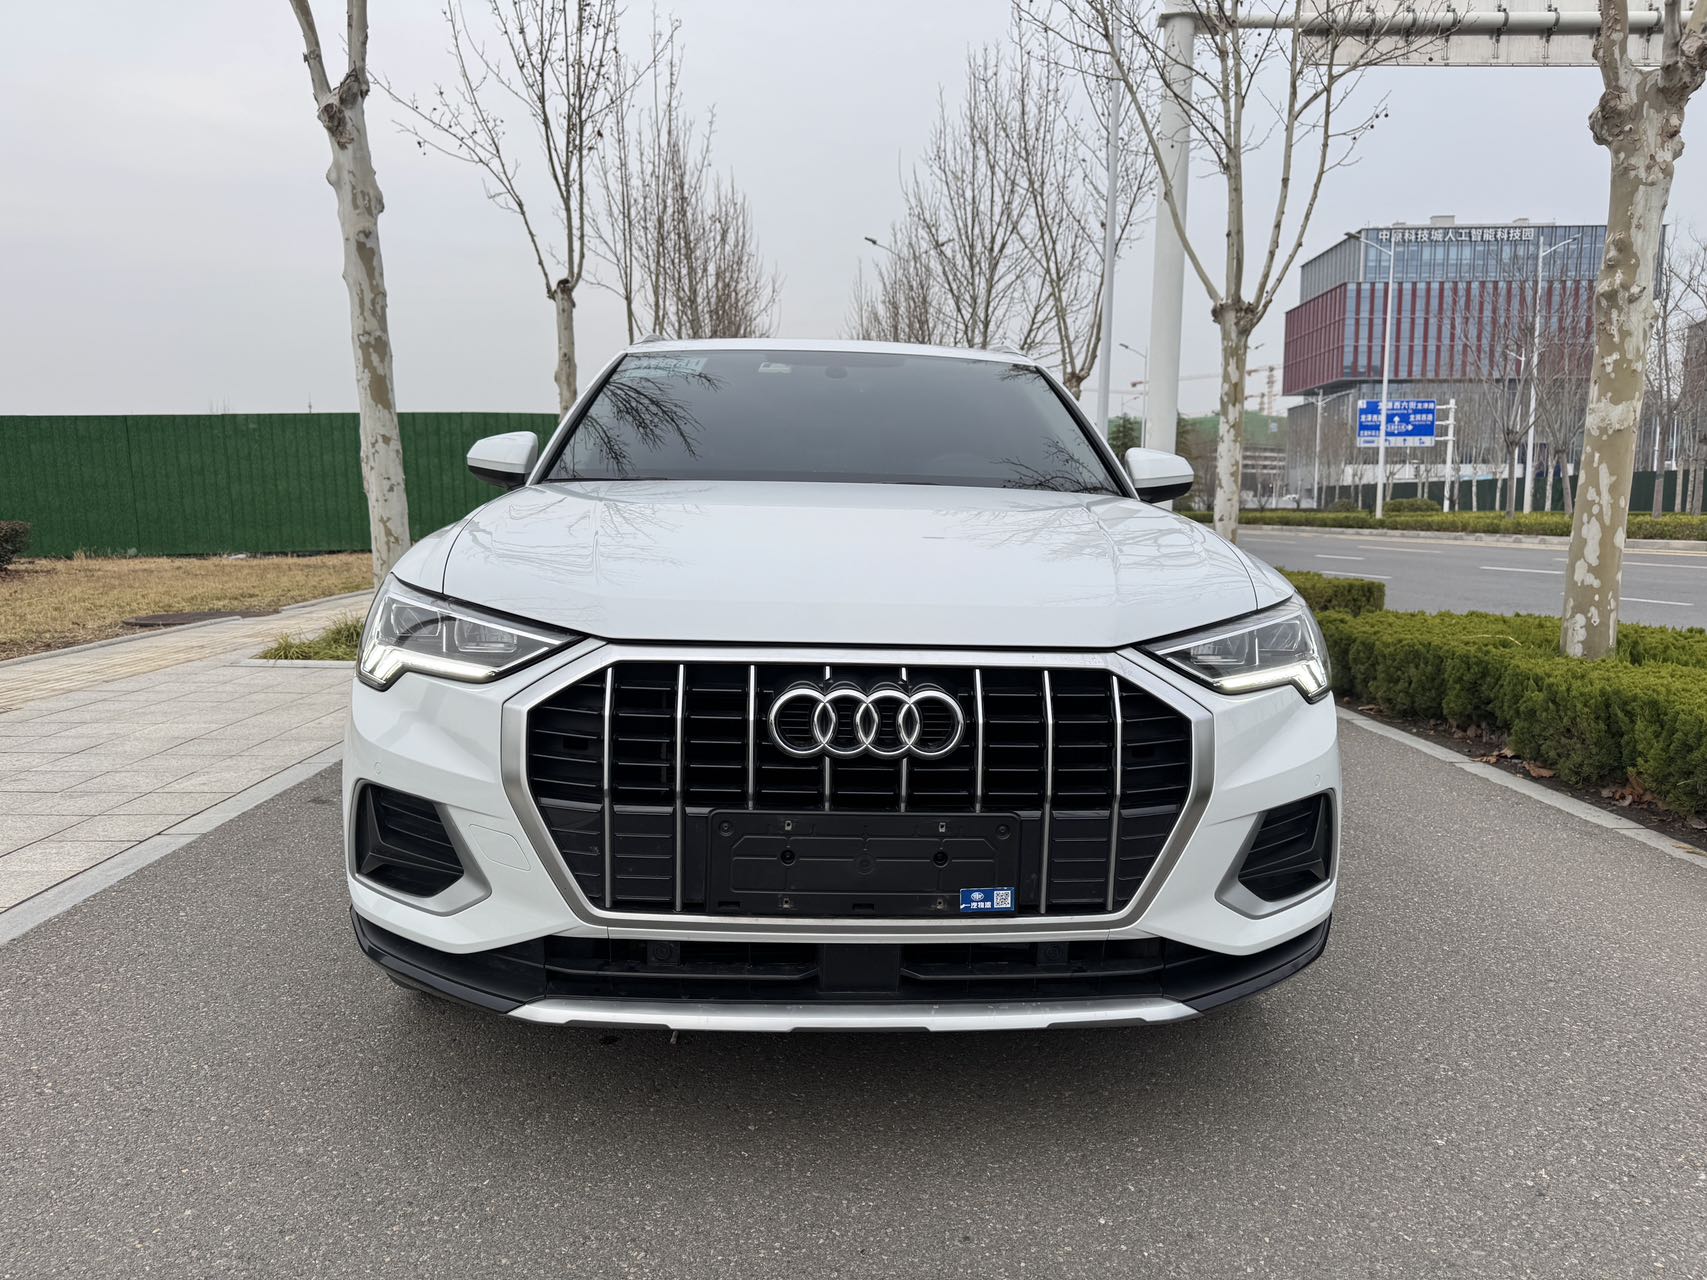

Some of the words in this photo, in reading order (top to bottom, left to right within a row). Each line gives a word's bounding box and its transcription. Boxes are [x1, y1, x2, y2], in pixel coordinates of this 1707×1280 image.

[1378, 227, 1534, 242] 中原科技城人工智能科技园
